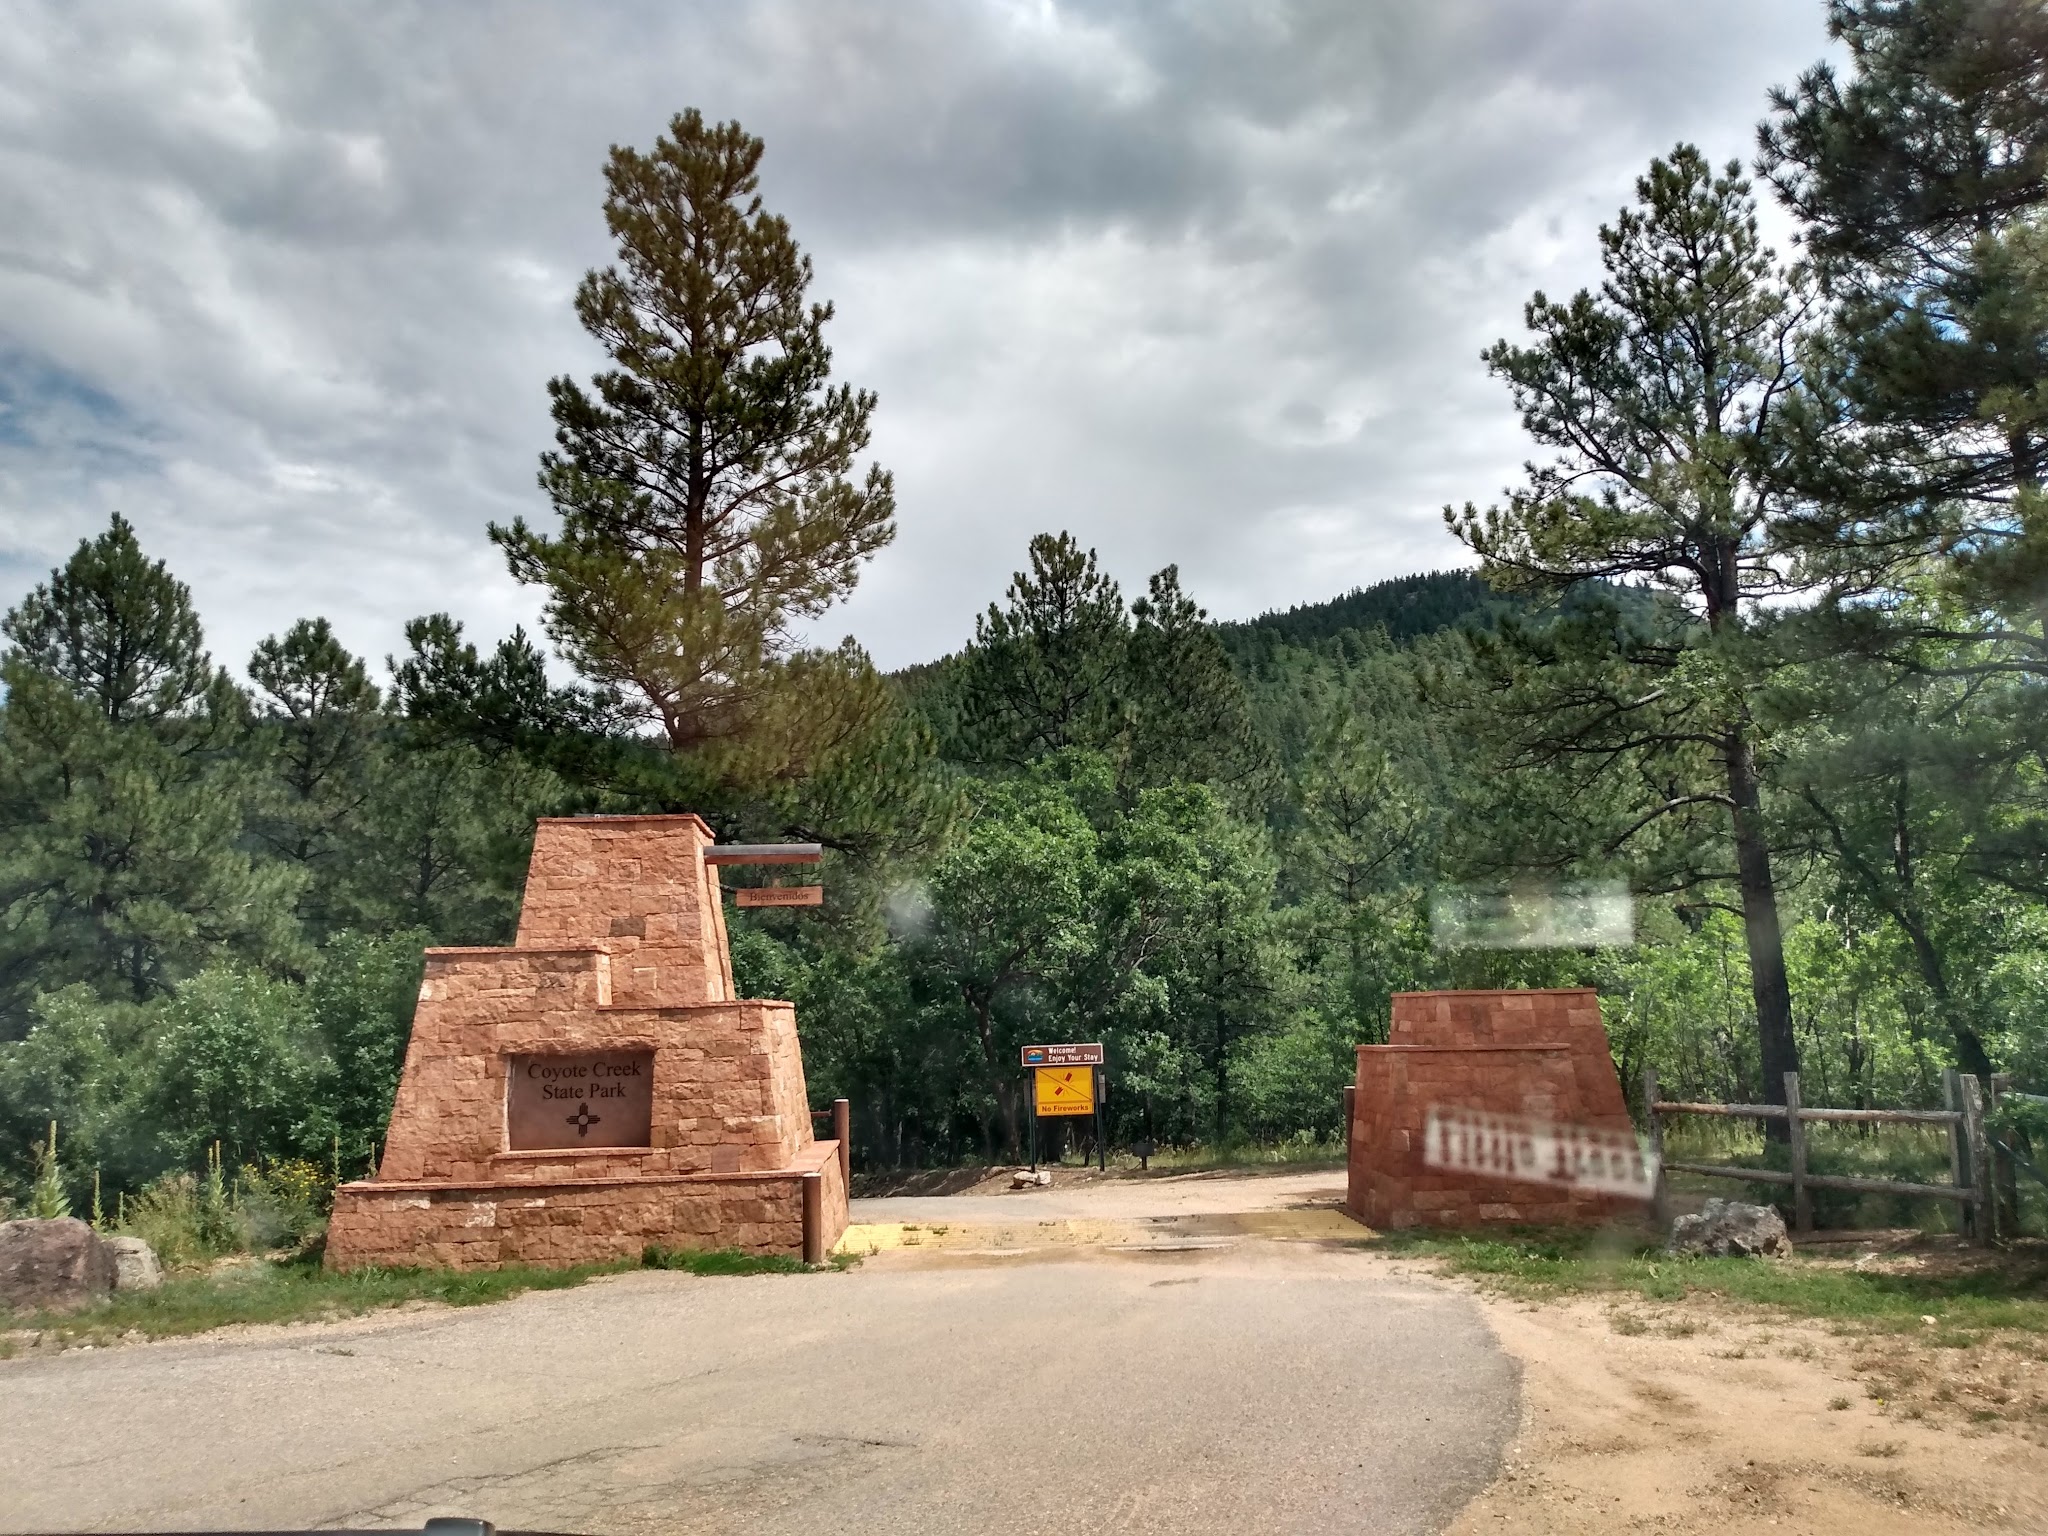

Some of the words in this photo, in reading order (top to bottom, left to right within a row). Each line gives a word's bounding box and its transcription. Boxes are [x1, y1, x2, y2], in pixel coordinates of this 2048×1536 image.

[750, 892, 809, 901] Bienvenidos
[1048, 1055, 1065, 1063] Enjoy
[528, 1064, 587, 1082] Coyote
[593, 1061, 640, 1077] Creek
[543, 1085, 583, 1099] State
[590, 1083, 626, 1098] Park
